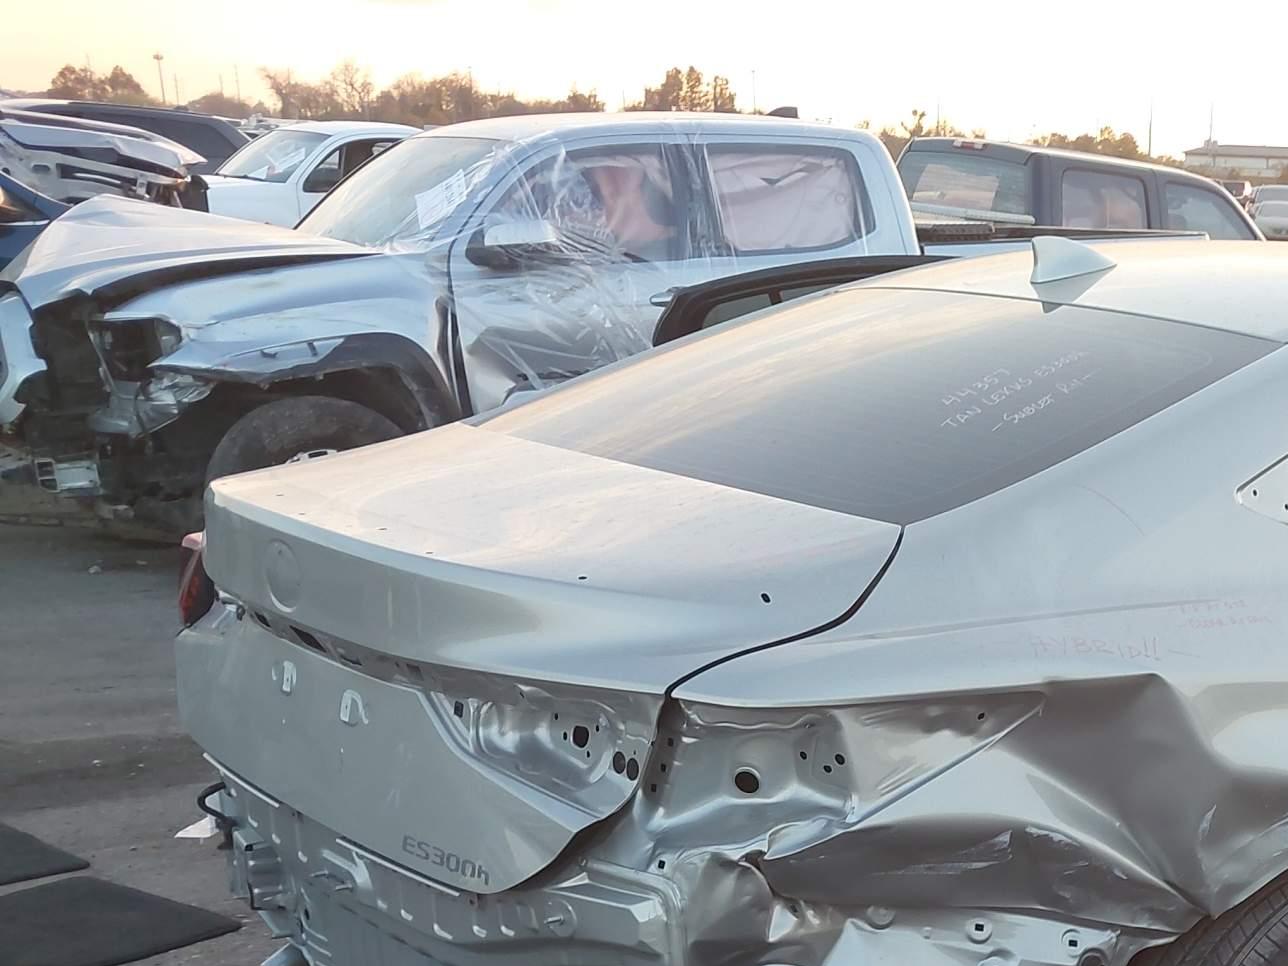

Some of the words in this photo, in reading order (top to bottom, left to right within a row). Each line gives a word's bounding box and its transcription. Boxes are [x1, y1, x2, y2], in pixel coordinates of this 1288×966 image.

[940, 405, 982, 429] TAN
[982, 376, 1033, 405] LEXUS
[942, 367, 1011, 406] 44357
[401, 834, 490, 886] ES300h
